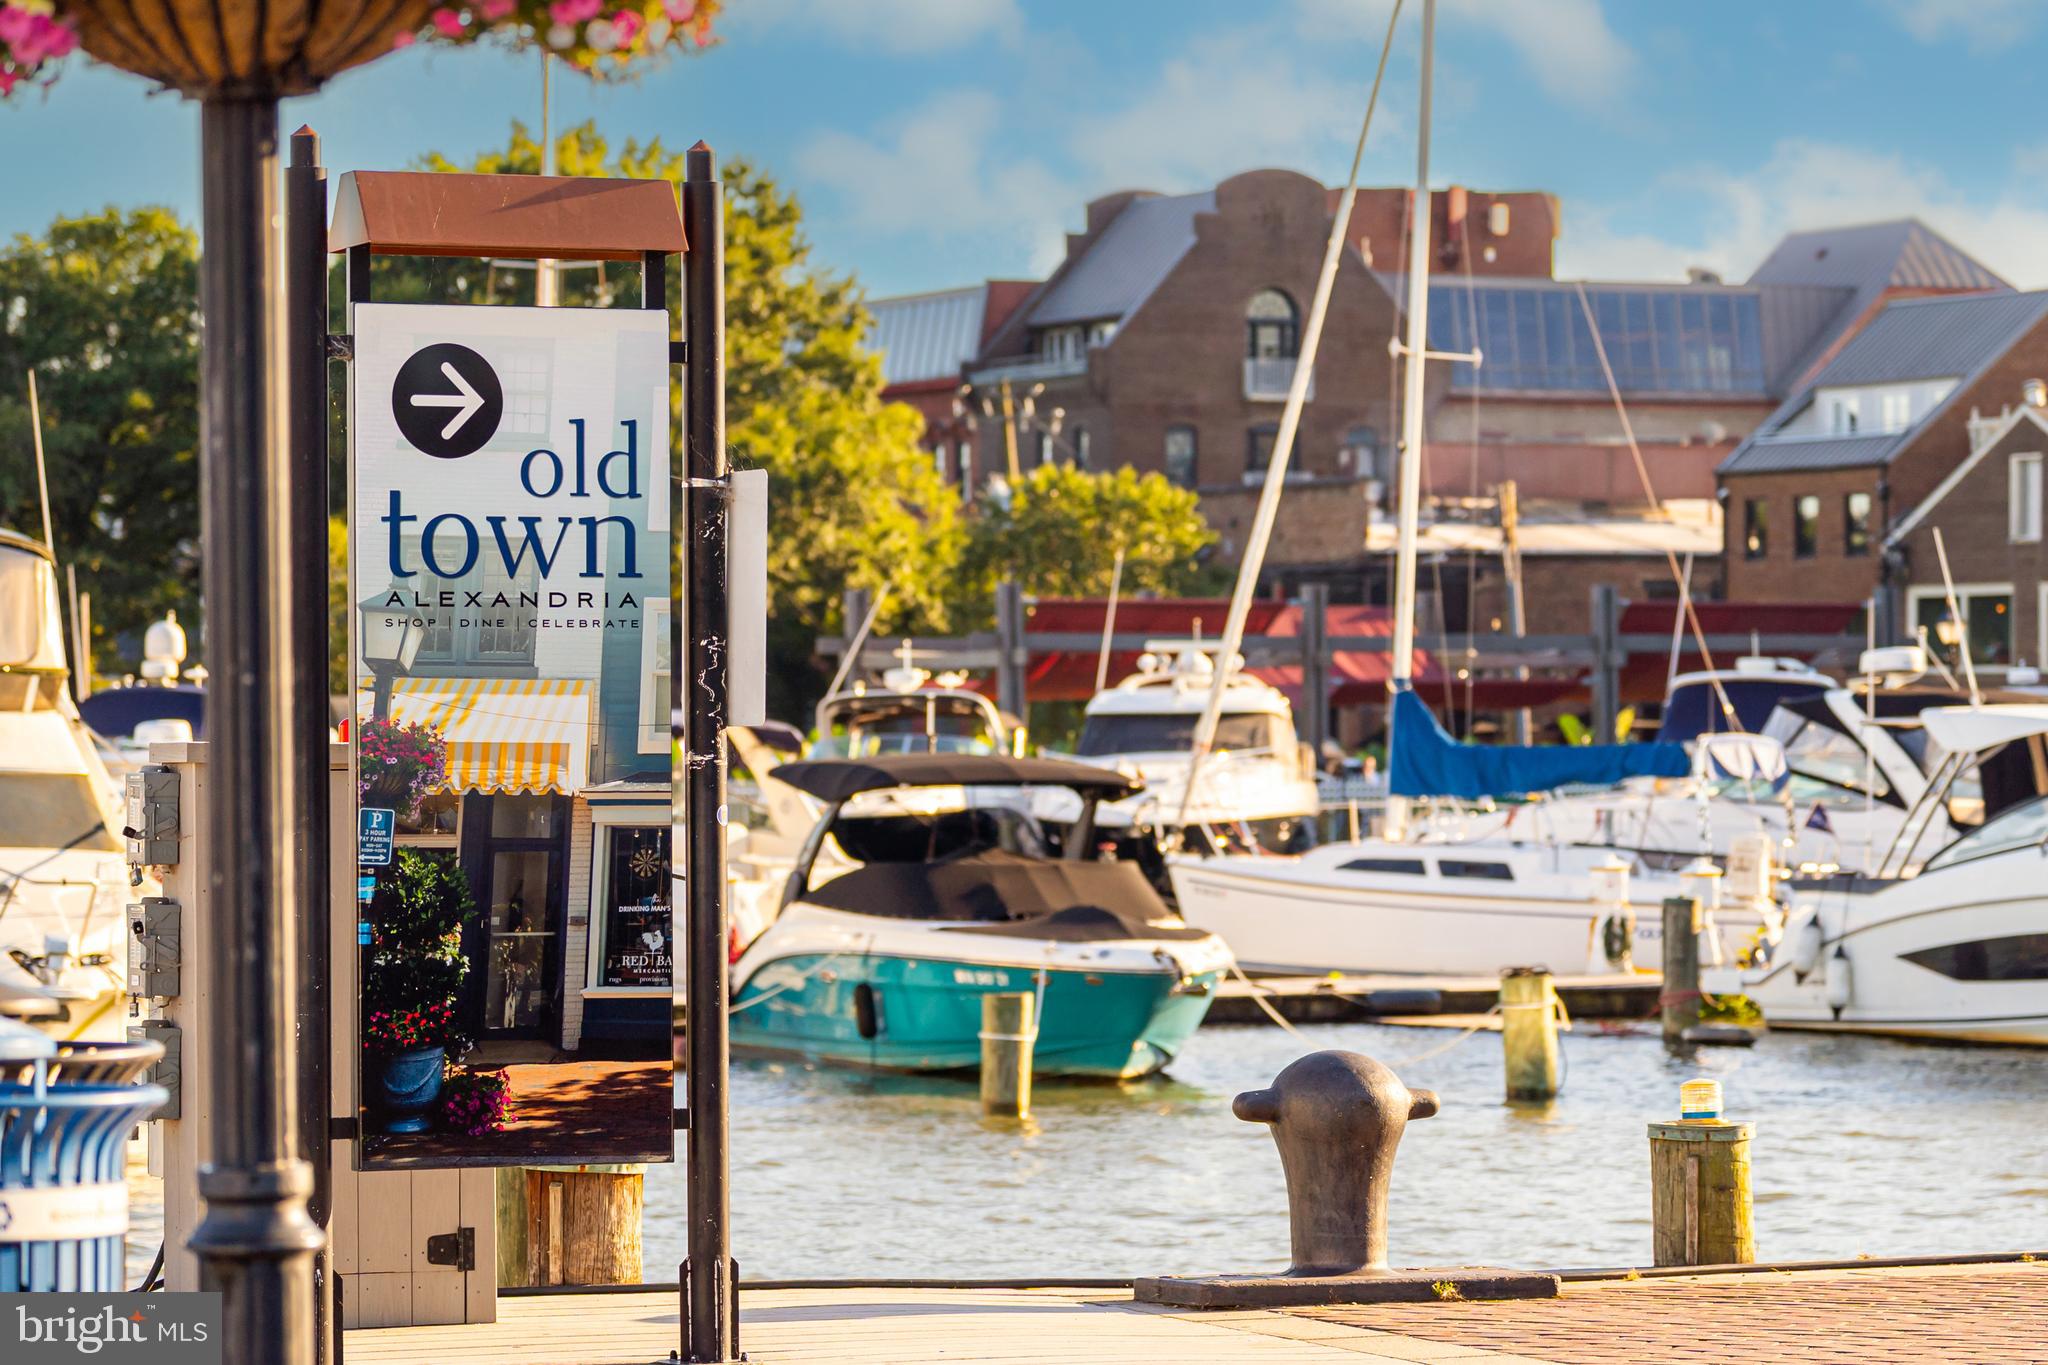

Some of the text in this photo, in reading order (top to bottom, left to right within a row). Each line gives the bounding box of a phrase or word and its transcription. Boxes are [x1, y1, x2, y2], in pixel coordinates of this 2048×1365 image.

[520, 418, 642, 498] old
[381, 490, 643, 579] town
[385, 591, 638, 608] ALEXANDRIA
[385, 618, 640, 628] SHOP DINE CELEBRATE
[371, 812, 383, 828] P
[370, 829, 386, 837] HOUR
[622, 955, 648, 966] RED
